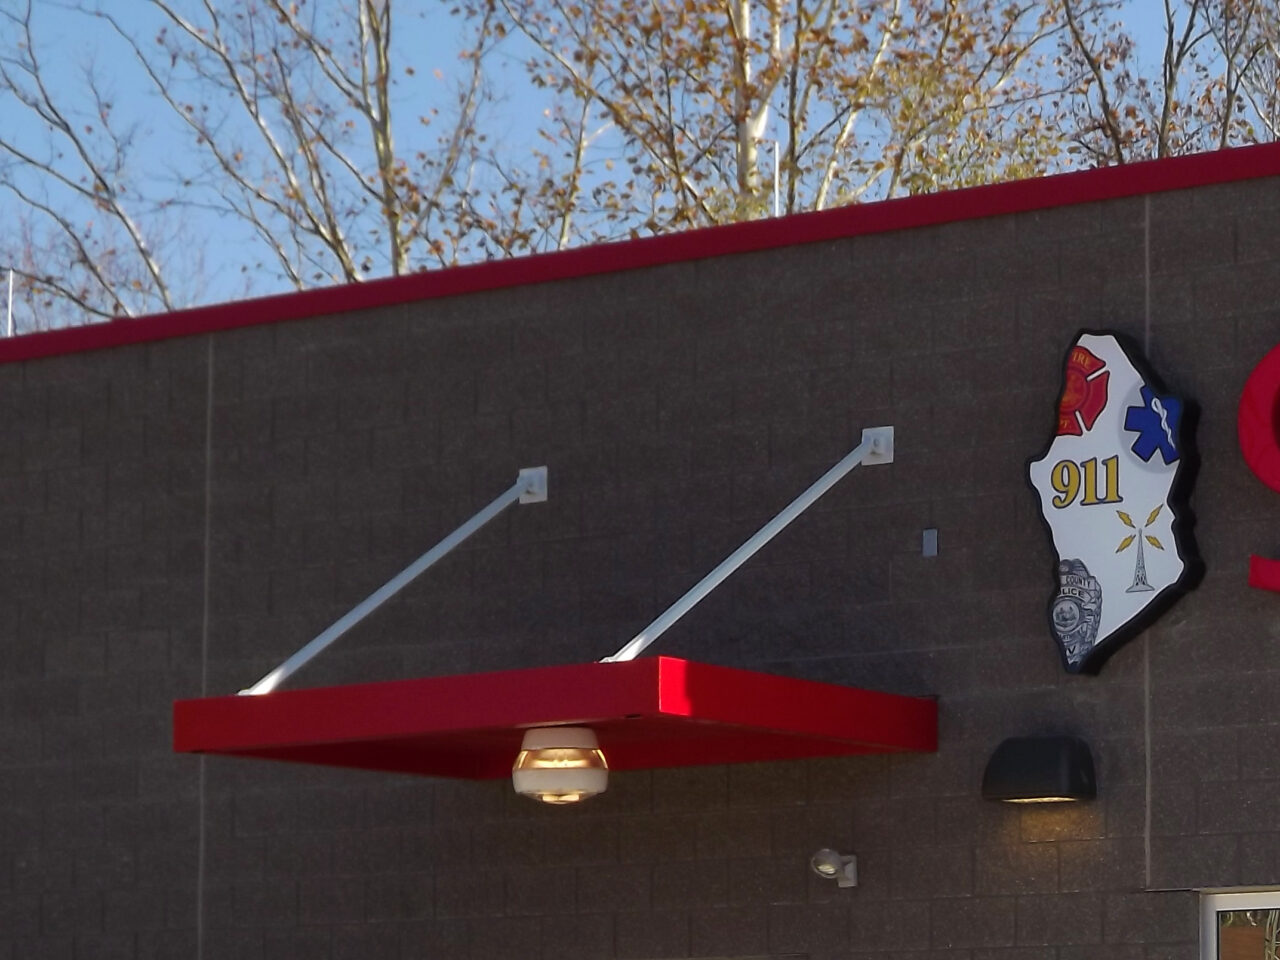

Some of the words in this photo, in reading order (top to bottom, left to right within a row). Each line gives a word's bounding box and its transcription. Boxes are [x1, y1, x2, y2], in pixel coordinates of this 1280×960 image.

[1072, 351, 1090, 369] IRE
[1051, 454, 1123, 509] 911
[1065, 575, 1091, 588] COUNTY
[1056, 588, 1085, 598] LICE
